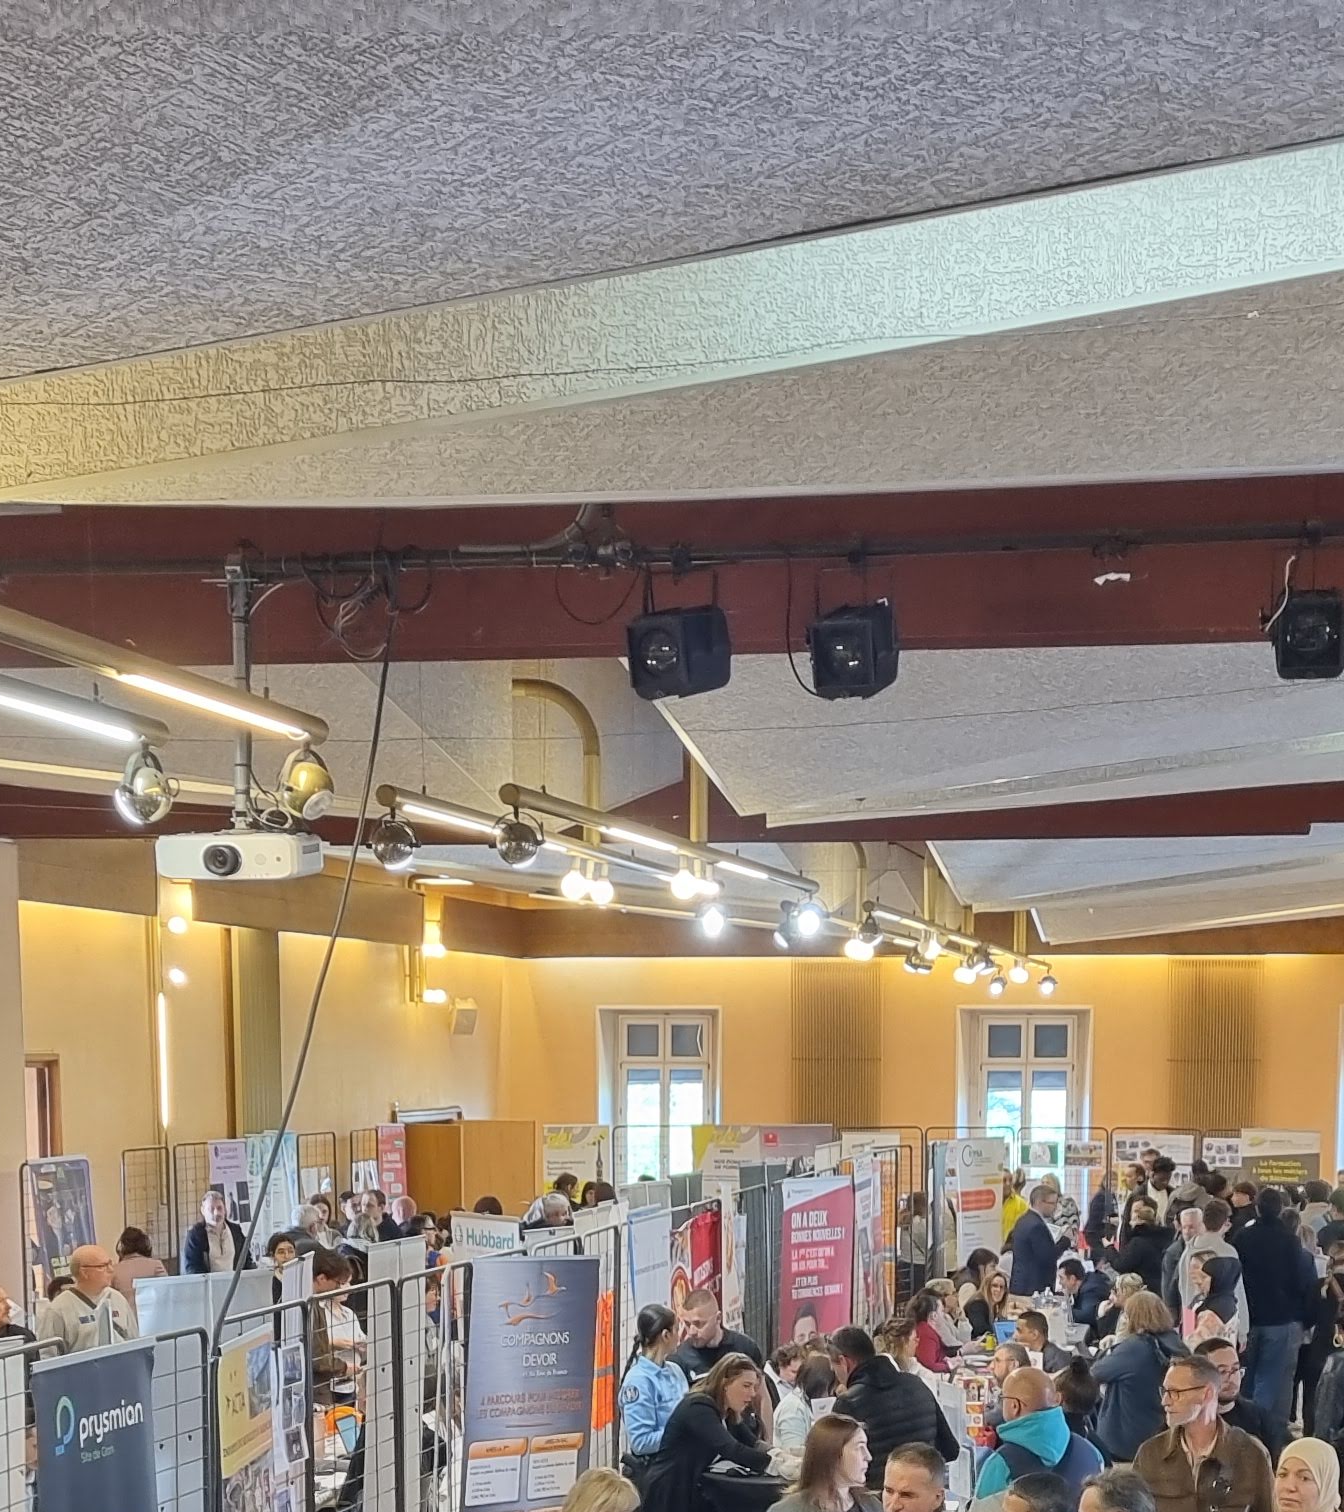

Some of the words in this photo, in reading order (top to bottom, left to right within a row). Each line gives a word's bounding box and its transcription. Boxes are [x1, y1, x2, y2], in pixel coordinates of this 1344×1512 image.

[791, 1212, 801, 1228] ON
[802, 1211, 808, 1227] A
[809, 1210, 828, 1227] DEUX
[466, 1227, 514, 1249] Hubbard
[501, 1330, 570, 1347] COMPAGNONS
[79, 1399, 144, 1449] prysmian
